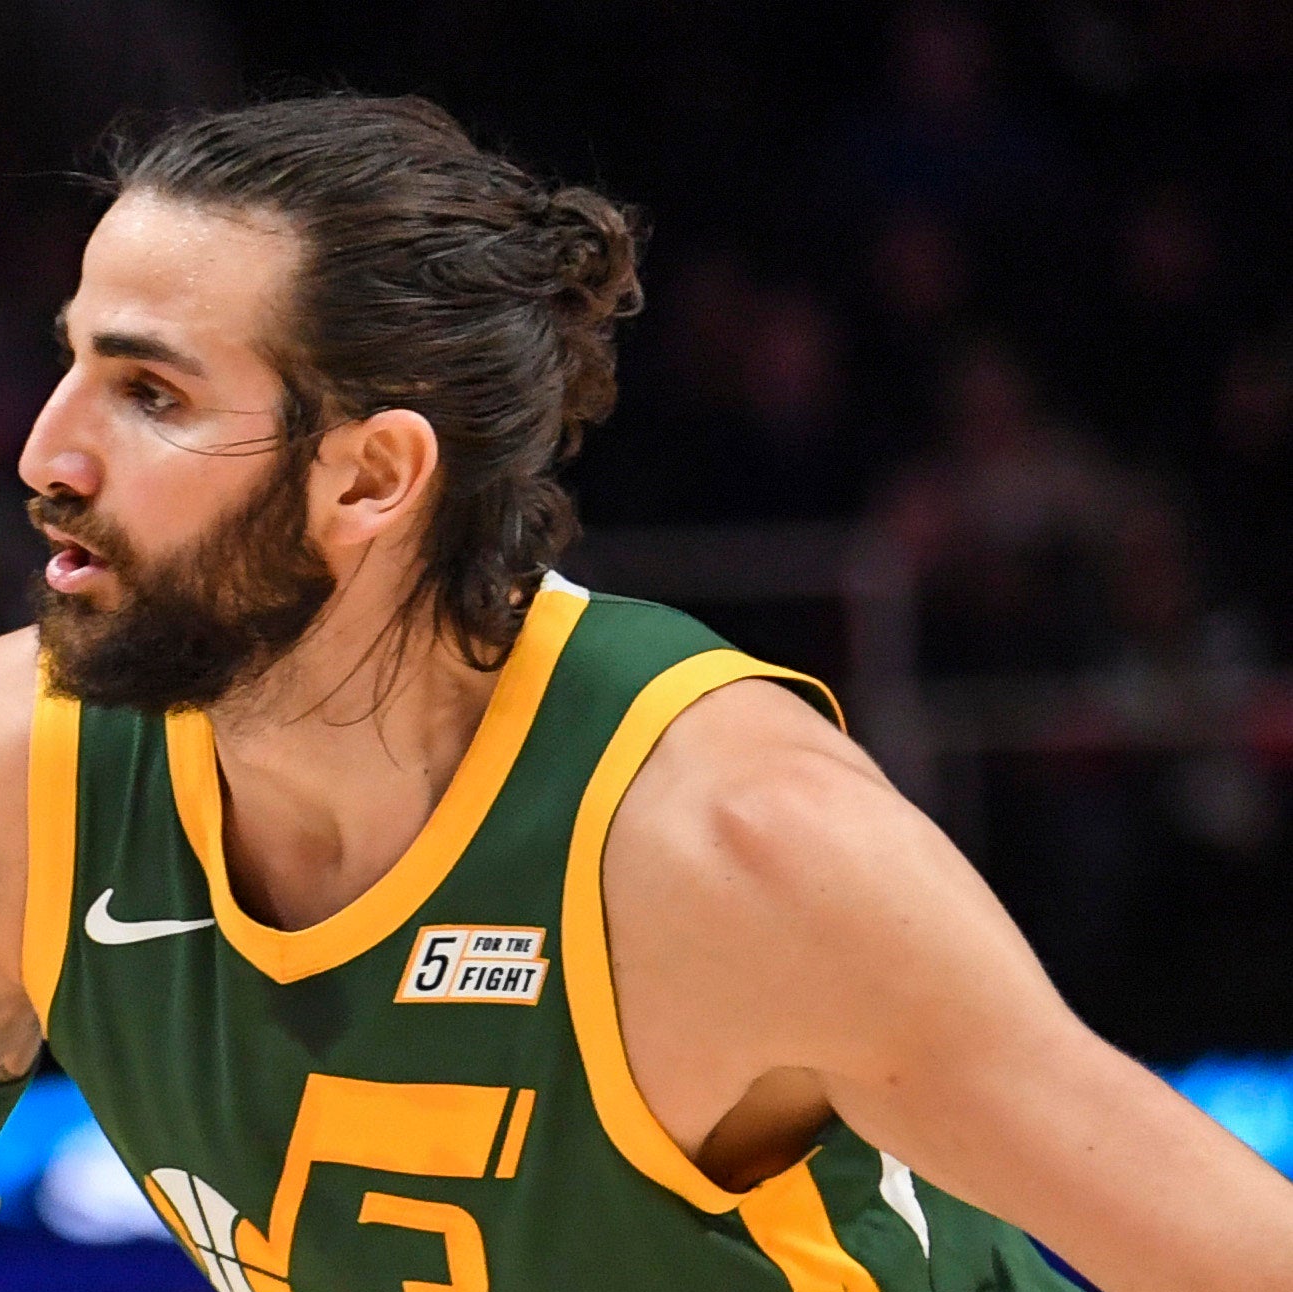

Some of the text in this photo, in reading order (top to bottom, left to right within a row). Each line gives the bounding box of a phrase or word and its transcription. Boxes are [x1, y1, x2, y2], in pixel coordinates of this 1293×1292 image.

[472, 936, 533, 953] FOR THE
[414, 936, 458, 992] 5
[458, 966, 537, 993] FIGHT
